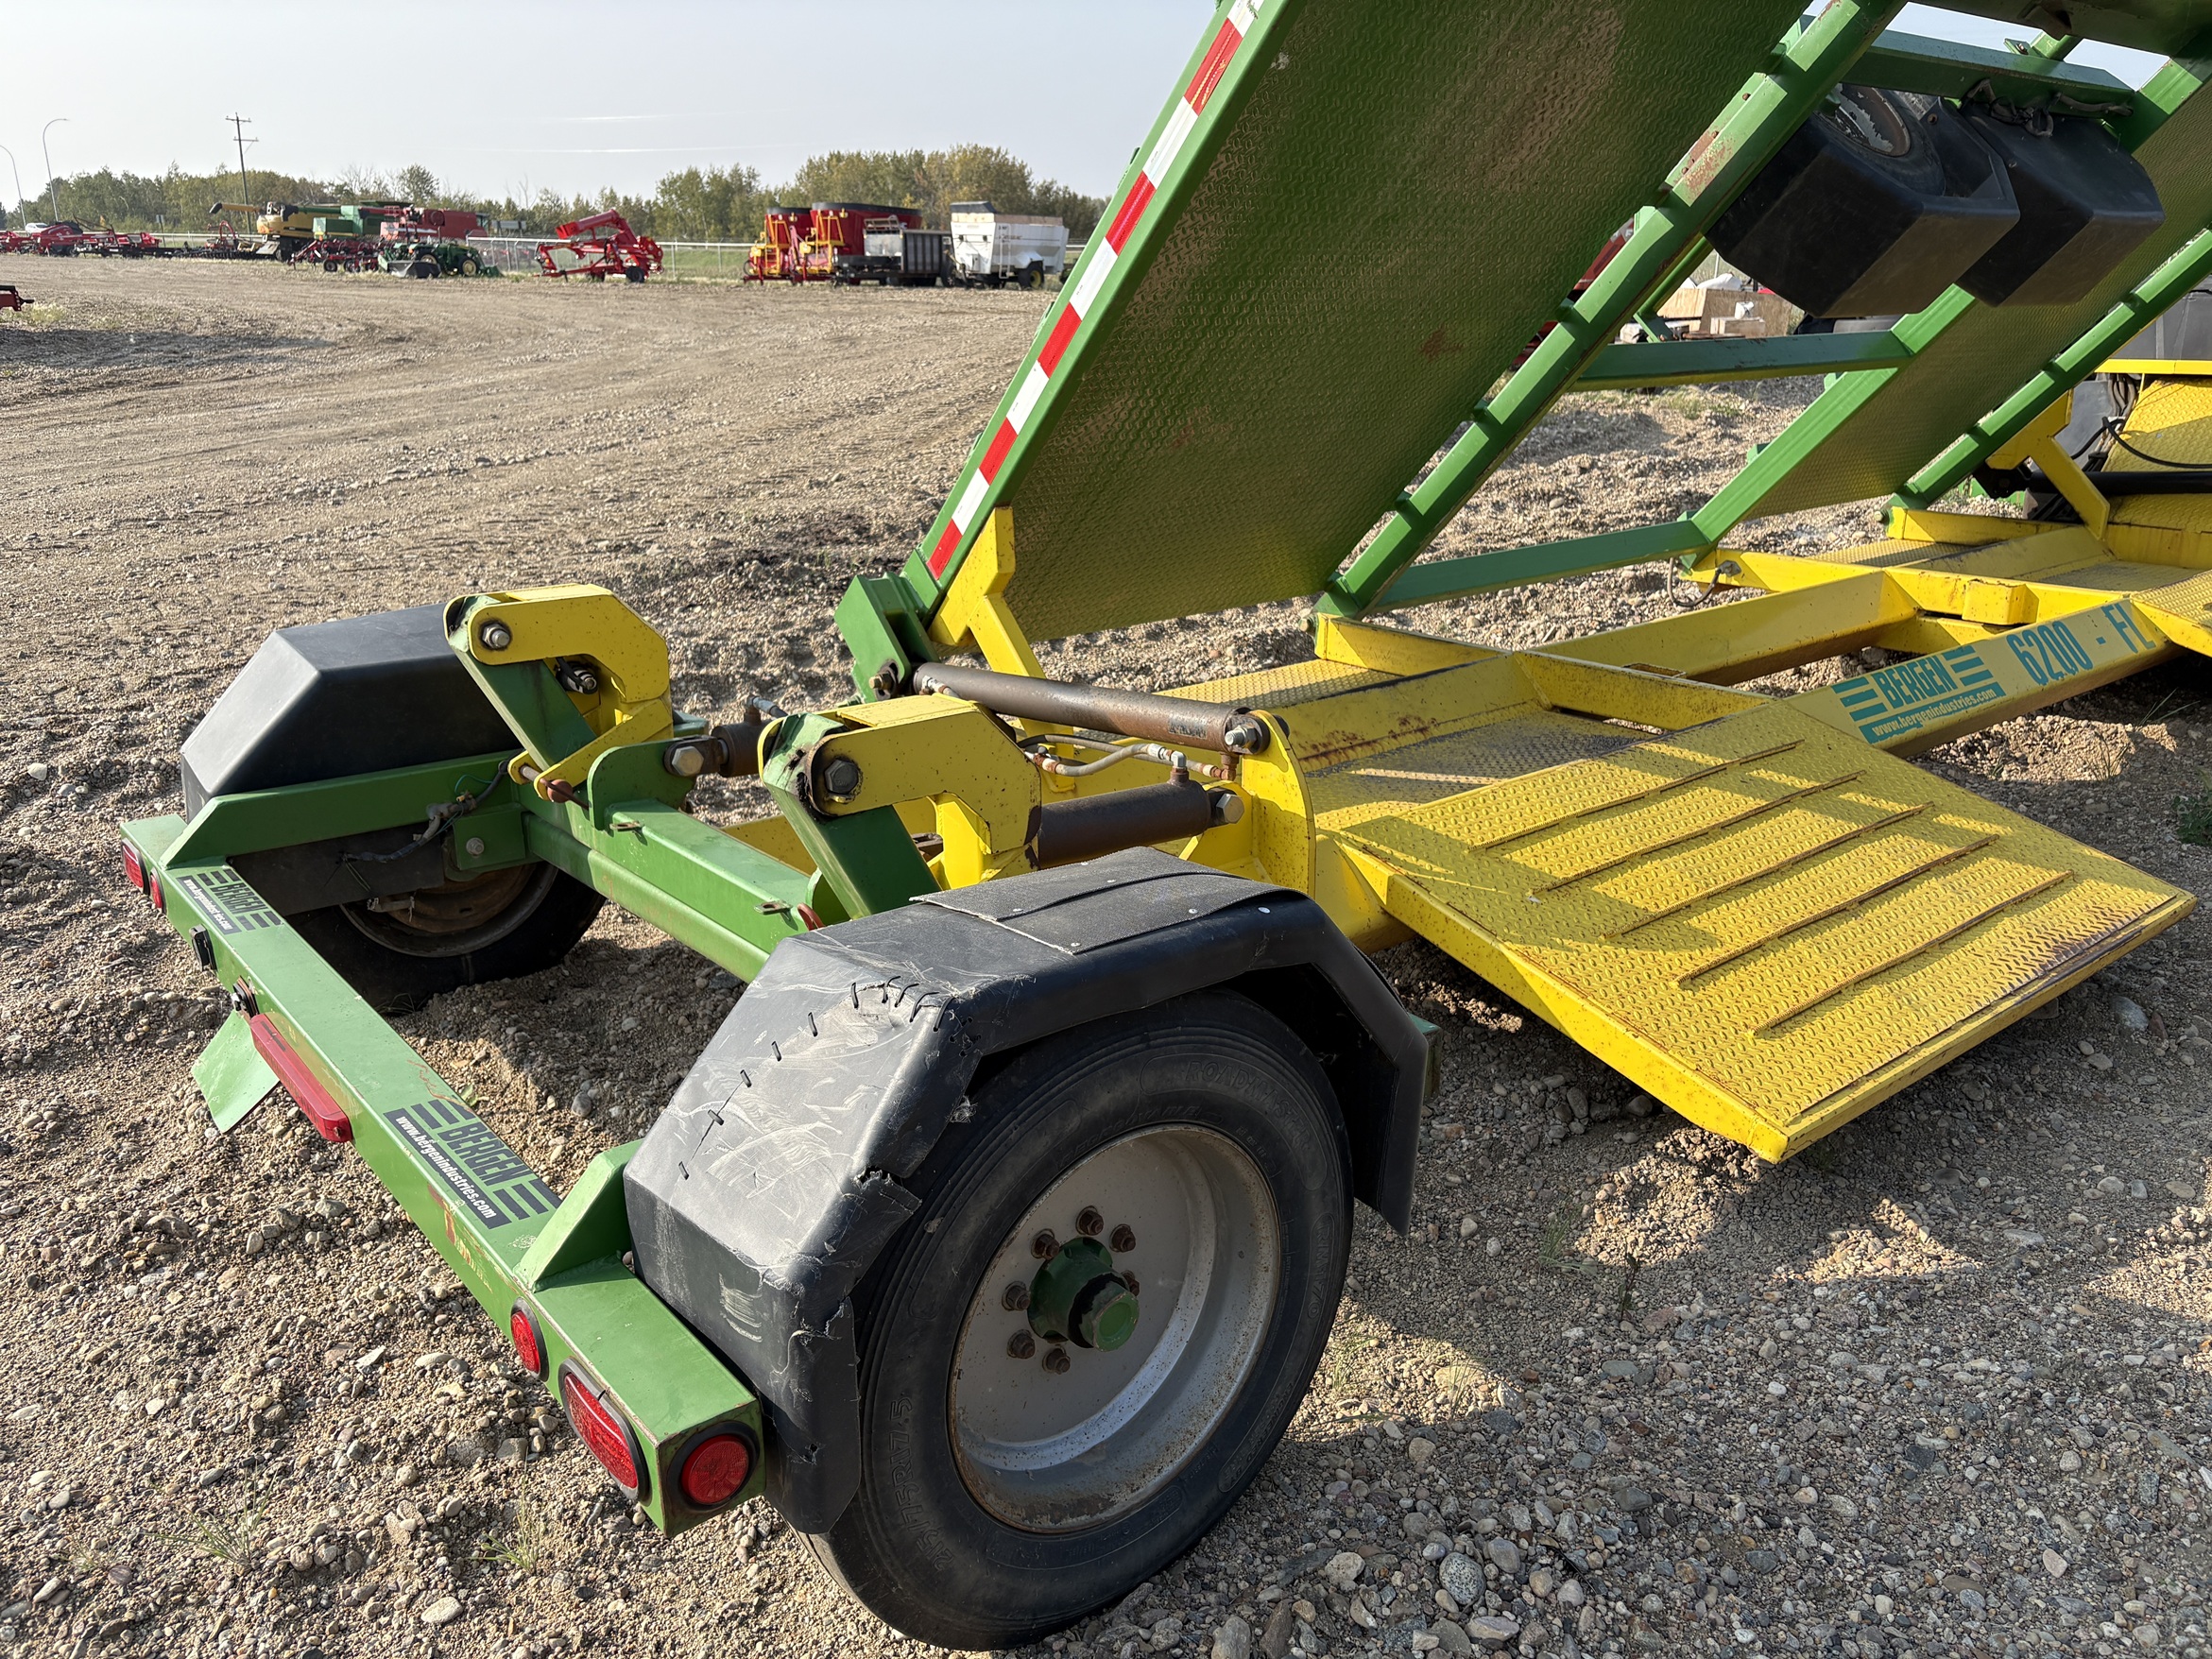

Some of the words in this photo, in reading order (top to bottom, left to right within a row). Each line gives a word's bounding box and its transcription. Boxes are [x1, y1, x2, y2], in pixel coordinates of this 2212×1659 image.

[1871, 655, 1958, 709] BERGEN
[2006, 621, 2093, 686] 6200
[2101, 603, 2156, 654] FL
[1872, 688, 1997, 736] www.bergenindustries.com
[183, 879, 233, 930] www.bergenindusties.com
[210, 882, 268, 915] BERGEN
[1185, 1060, 1311, 1151] ROADMASTER
[395, 1116, 496, 1219] www.bergenindustries.com
[437, 1121, 533, 1186] BERGEN
[889, 1397, 954, 1572] 215/75R17.5
